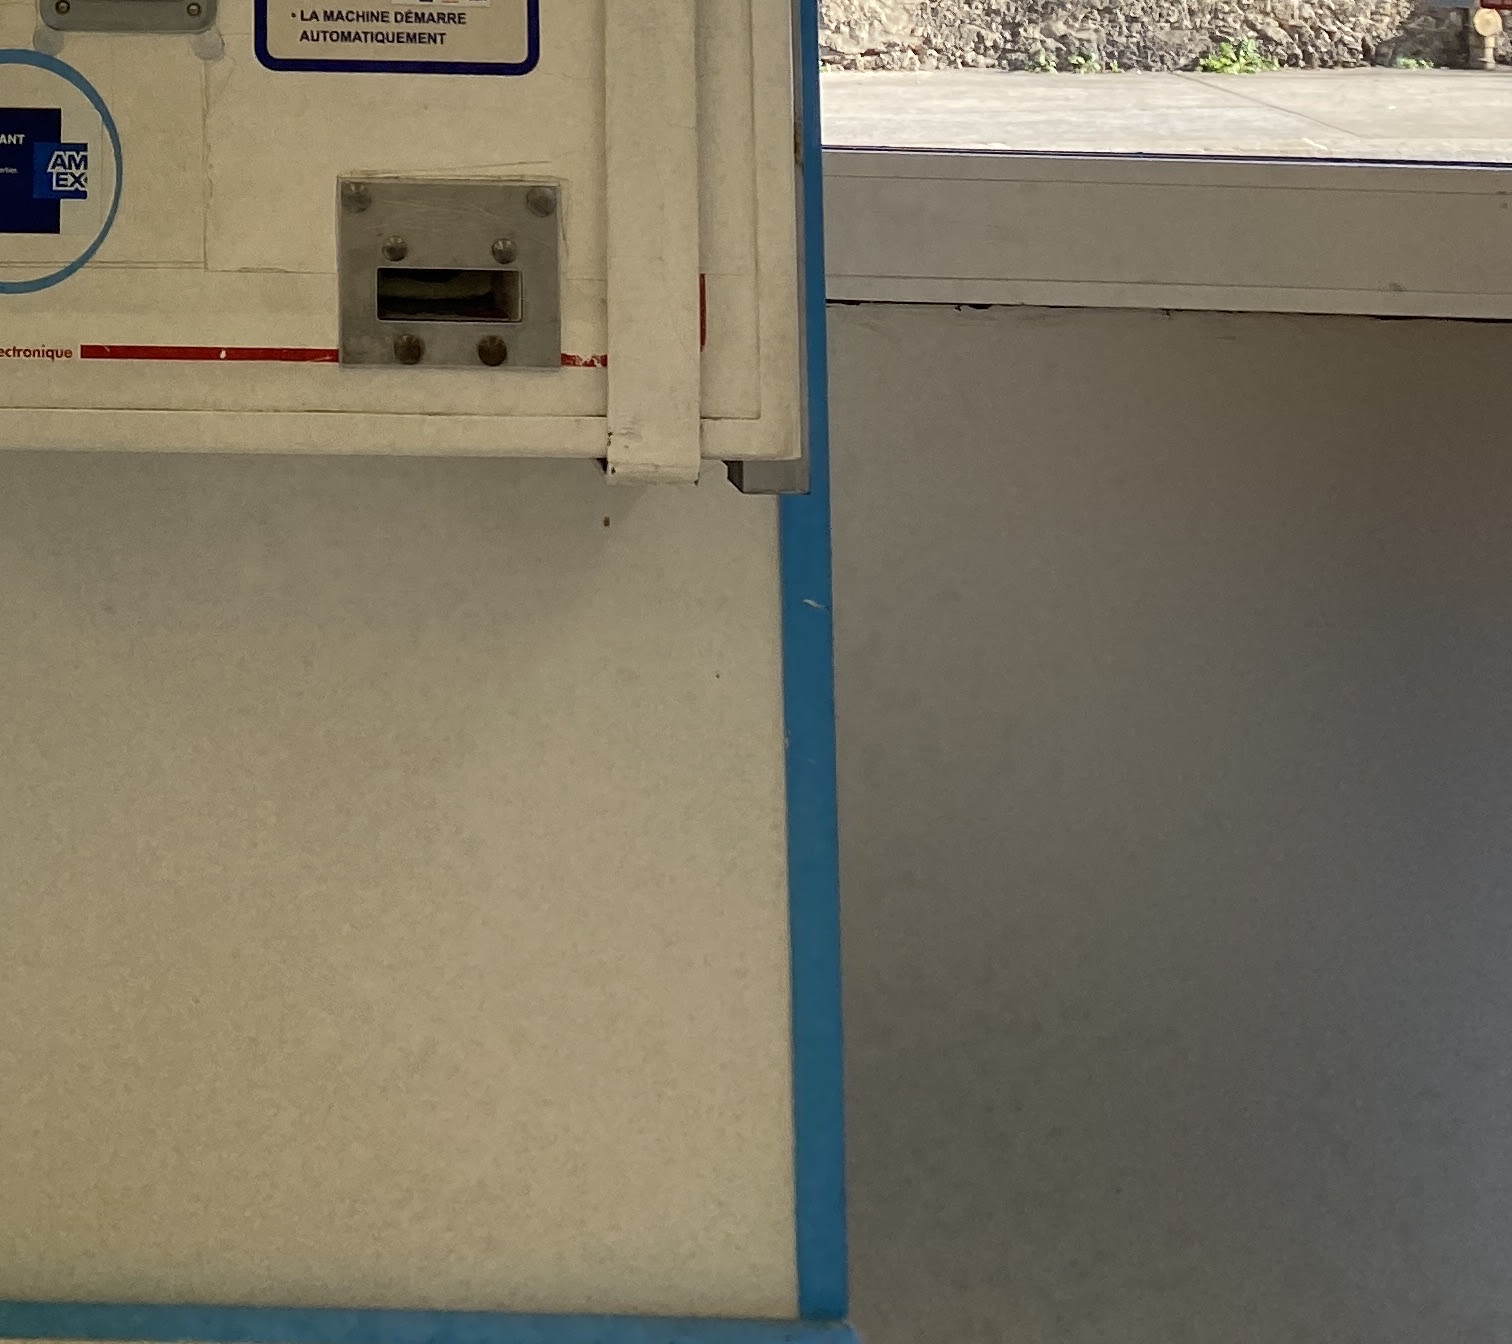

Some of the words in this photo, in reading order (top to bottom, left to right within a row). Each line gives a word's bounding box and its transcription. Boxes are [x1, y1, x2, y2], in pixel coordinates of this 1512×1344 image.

[299, 30, 446, 45] AUTOMATIQUEMENT
[47, 151, 88, 173] AM
[52, 171, 88, 191] EX
